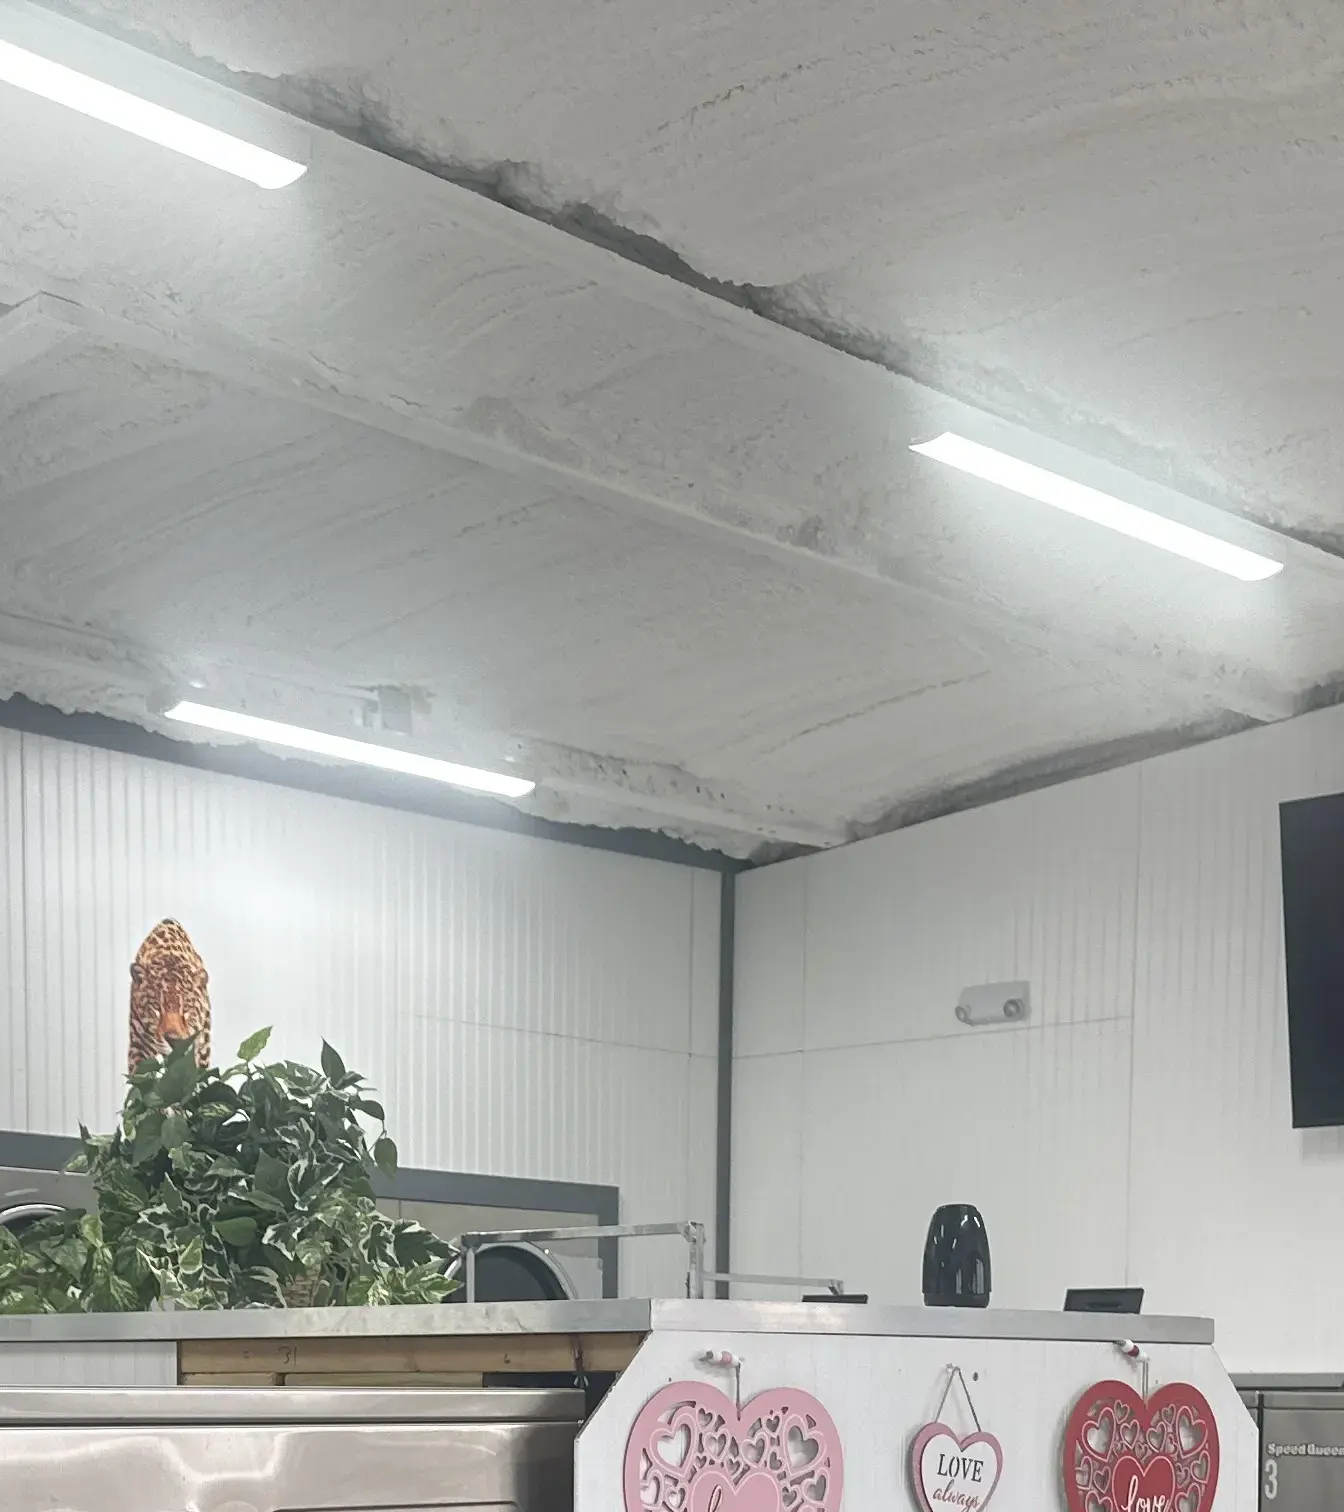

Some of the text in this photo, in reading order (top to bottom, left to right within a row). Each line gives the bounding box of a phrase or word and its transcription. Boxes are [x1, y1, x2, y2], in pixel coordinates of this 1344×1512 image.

[1267, 1442, 1306, 1457] Speed
[937, 1453, 984, 1483] LOVE
[1264, 1458, 1278, 1500] 3
